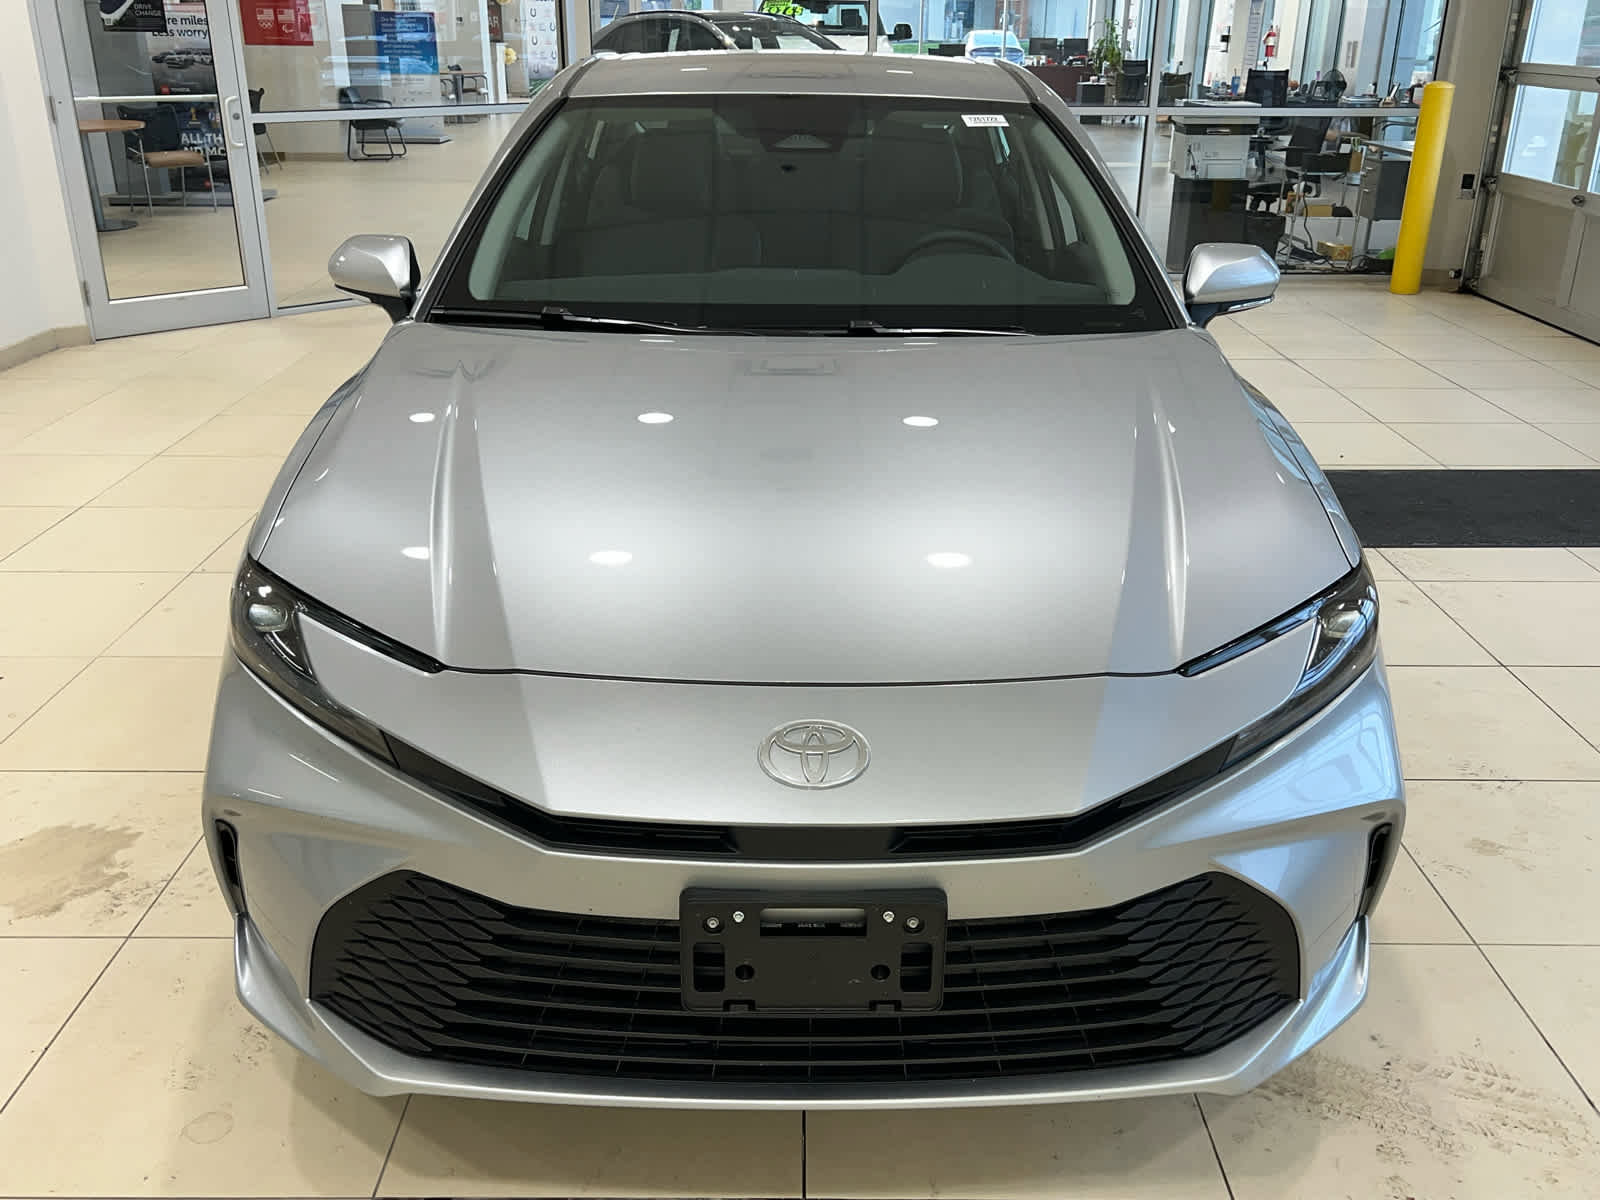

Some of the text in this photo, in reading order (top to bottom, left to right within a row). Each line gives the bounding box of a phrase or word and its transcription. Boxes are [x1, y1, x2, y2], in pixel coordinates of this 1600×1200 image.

[180, 15, 208, 25] miles
[177, 28, 208, 39] worry
[181, 133, 203, 144] ALL
